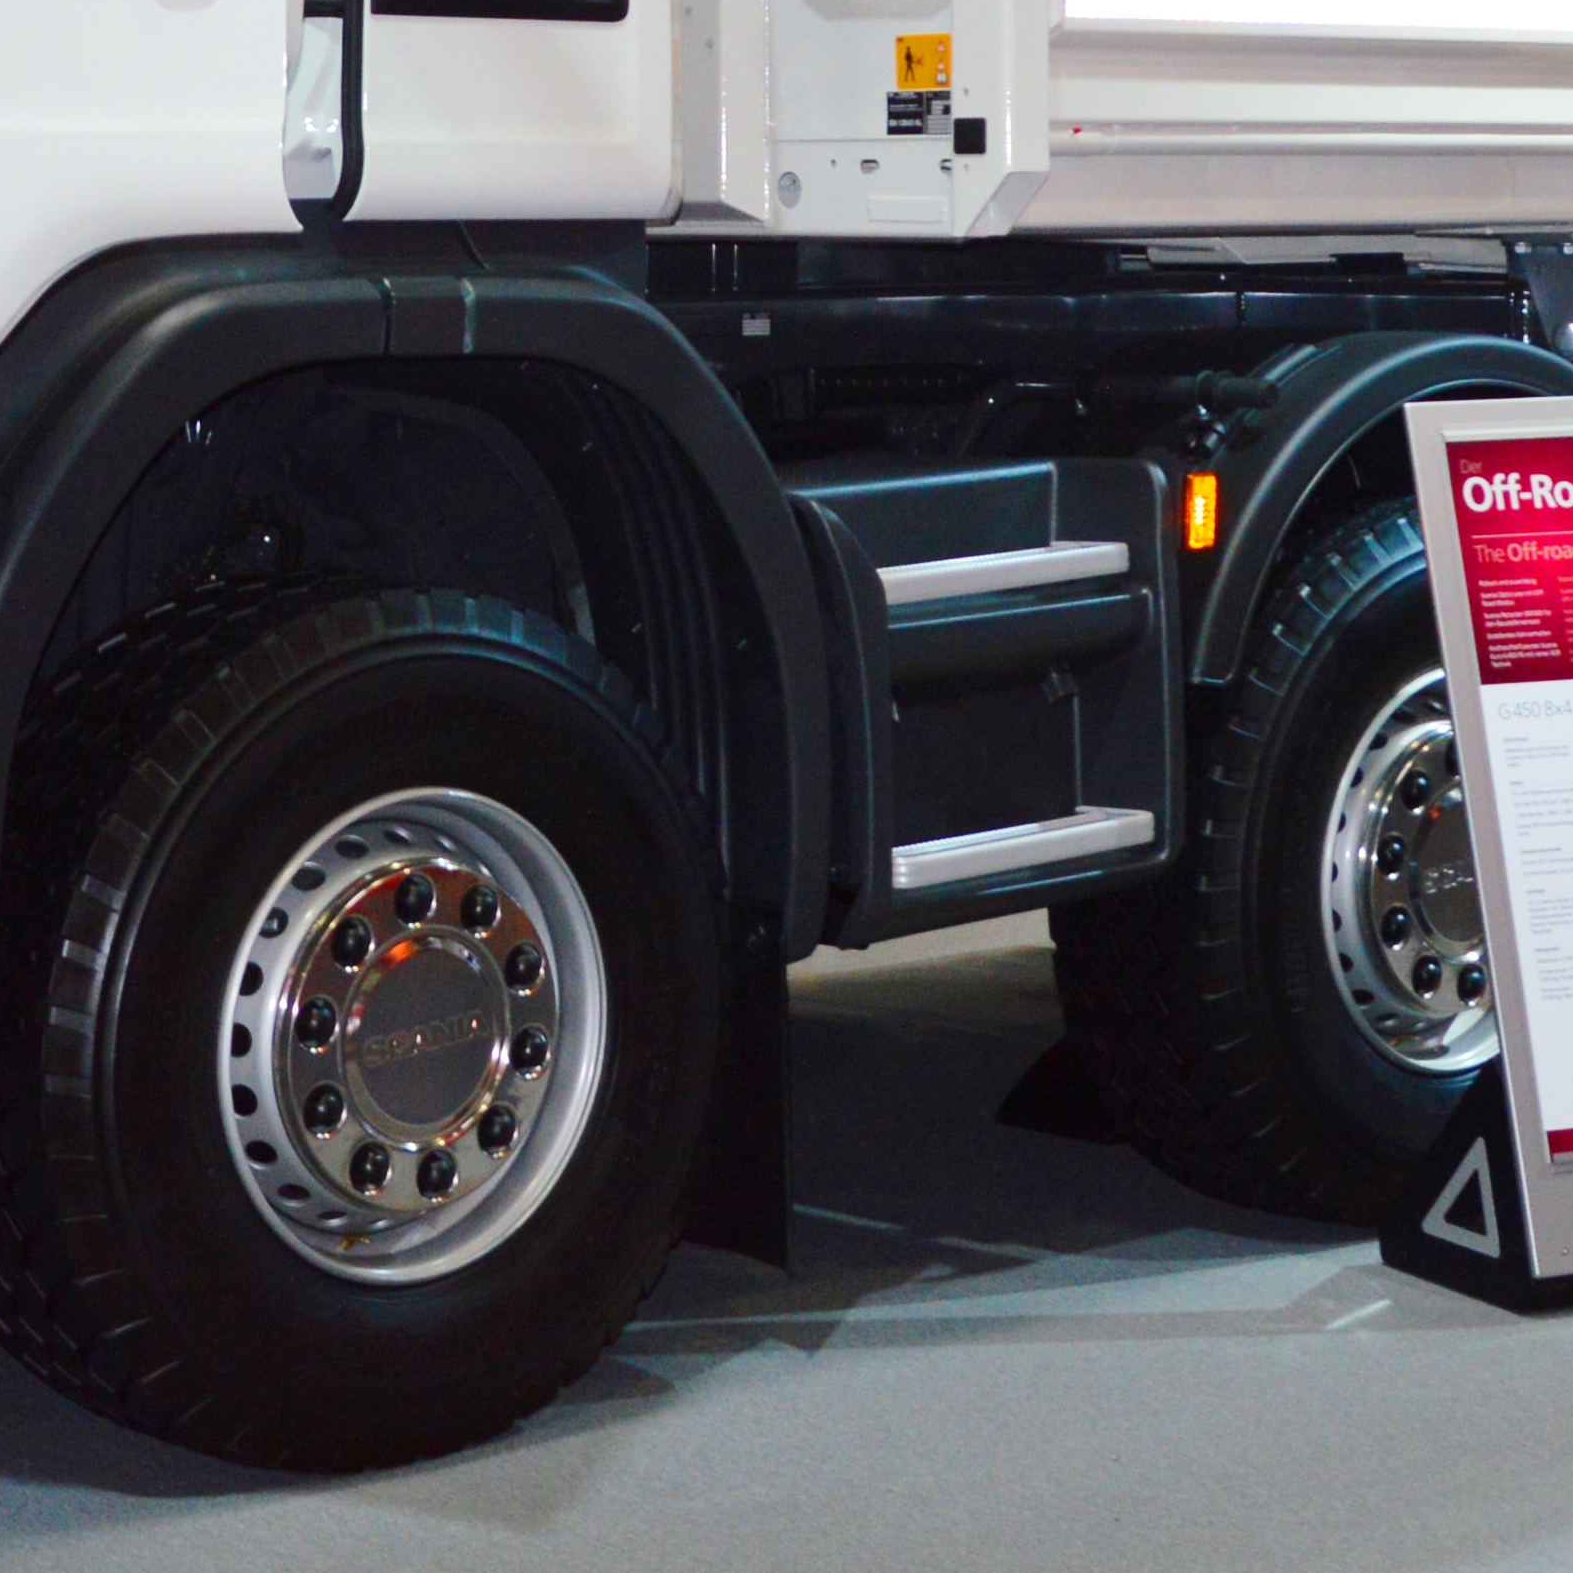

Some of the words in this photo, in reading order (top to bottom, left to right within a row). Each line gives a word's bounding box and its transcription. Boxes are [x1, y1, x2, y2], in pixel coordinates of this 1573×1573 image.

[1473, 544, 1505, 563] The
[1498, 703, 1512, 720] G
[1513, 702, 1541, 718] 450
[1544, 699, 1573, 716] 8x4
